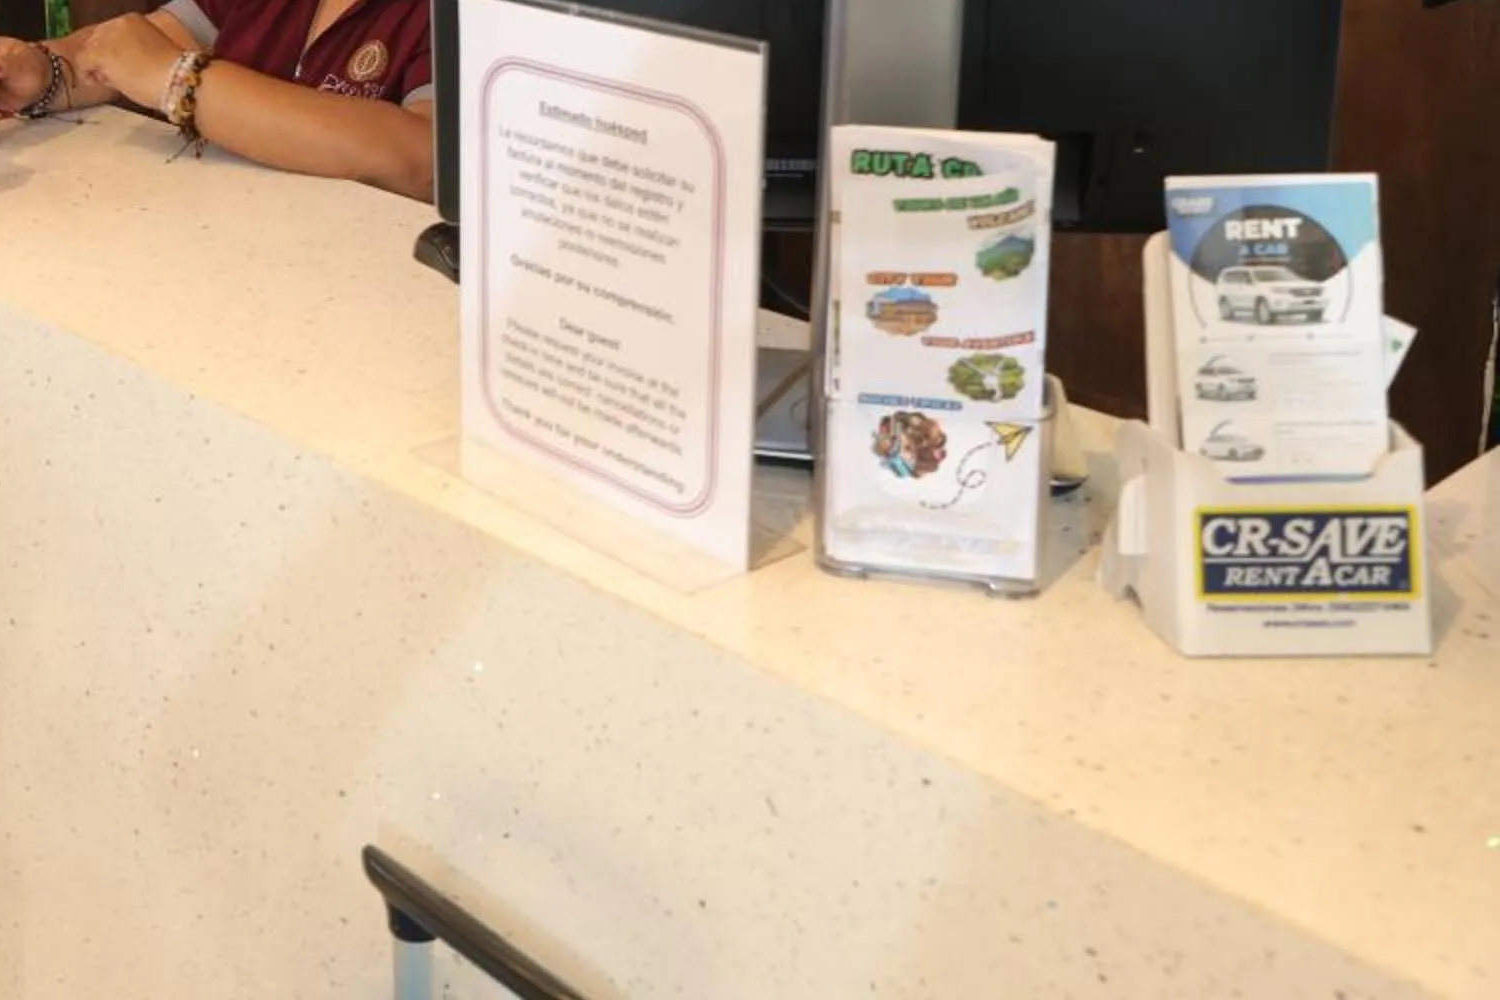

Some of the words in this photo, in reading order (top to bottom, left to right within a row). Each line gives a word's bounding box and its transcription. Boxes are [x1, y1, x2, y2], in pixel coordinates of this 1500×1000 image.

[851, 149, 934, 179] RUTA
[1224, 217, 1303, 240] RENT
[1253, 243, 1290, 256] CAR
[1202, 516, 1407, 562] CR-SAVE
[1223, 566, 1300, 586] RENT
[1301, 557, 1333, 586] A
[1333, 565, 1392, 586] CAR
